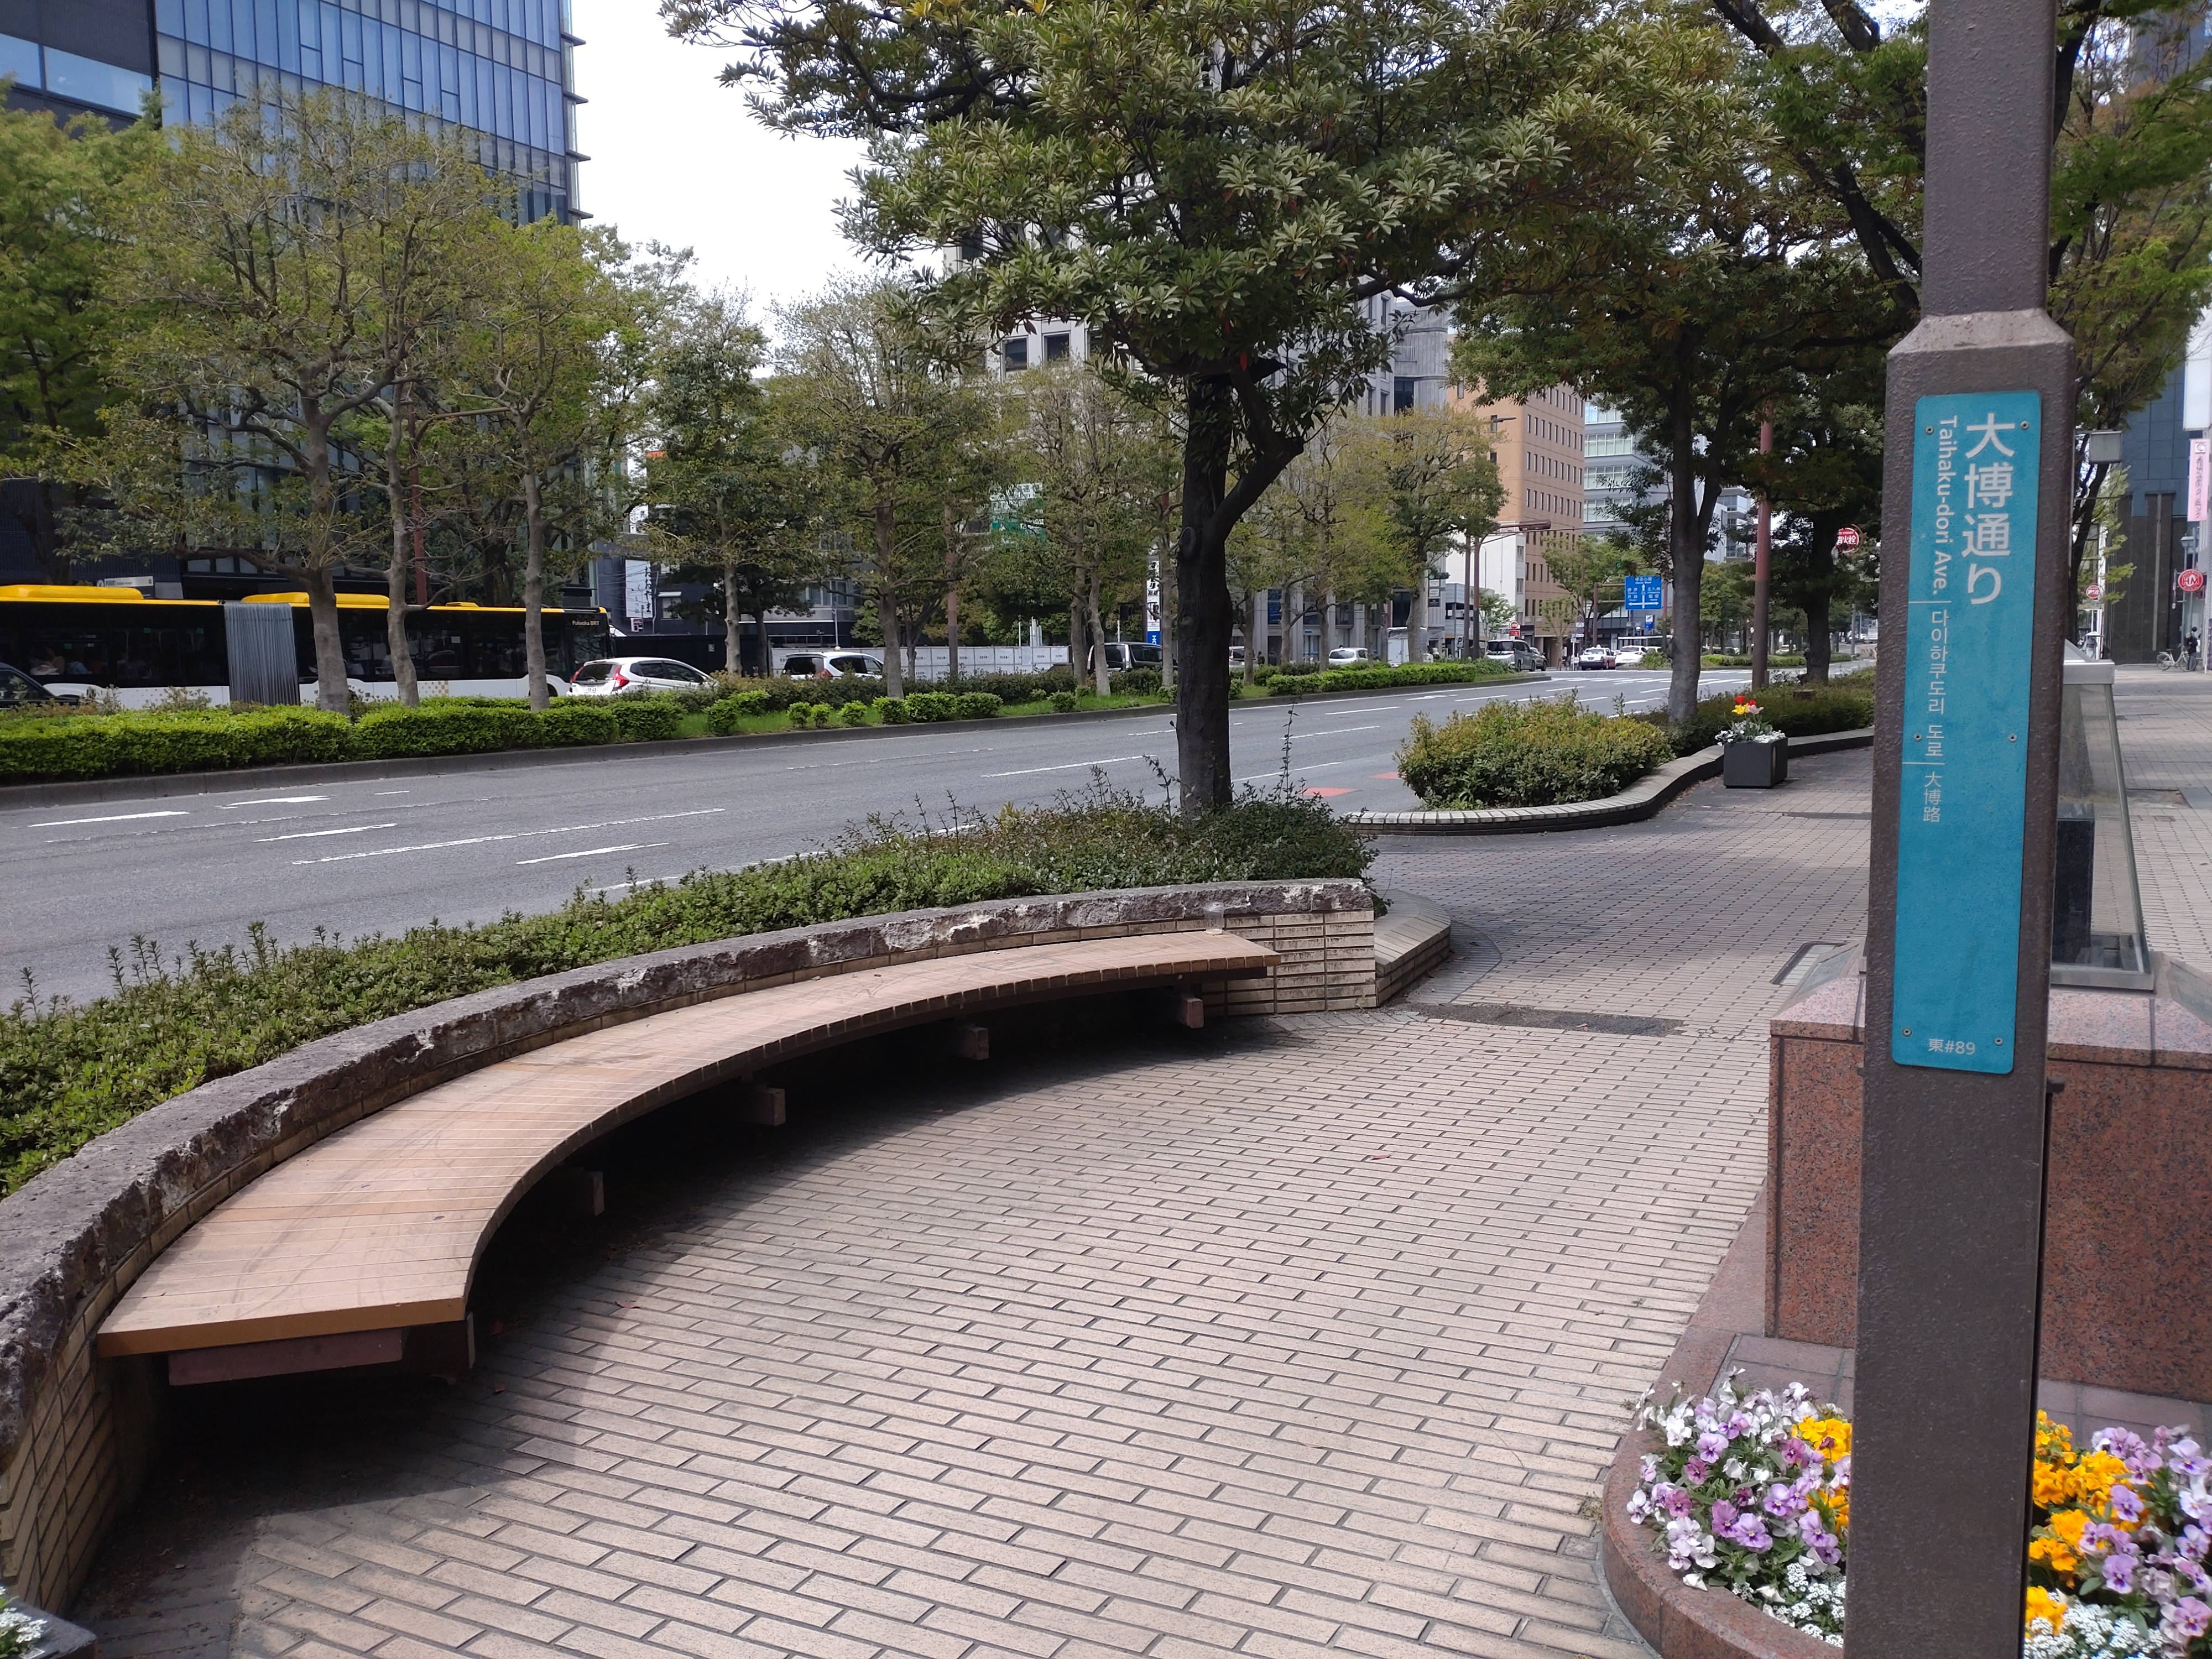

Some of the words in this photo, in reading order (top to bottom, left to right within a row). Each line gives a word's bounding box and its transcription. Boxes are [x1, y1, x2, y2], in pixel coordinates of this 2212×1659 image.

[1935, 415, 1958, 544] Taihaku-dori
[1961, 412, 2016, 605] 大博通り
[1933, 550, 1952, 595] Ave.
[1928, 609, 1951, 715] 다이하쿠도리
[1925, 724, 1945, 757] 도로
[1923, 770, 1943, 823] 大博路
[1928, 1039, 1975, 1055] 東#89
